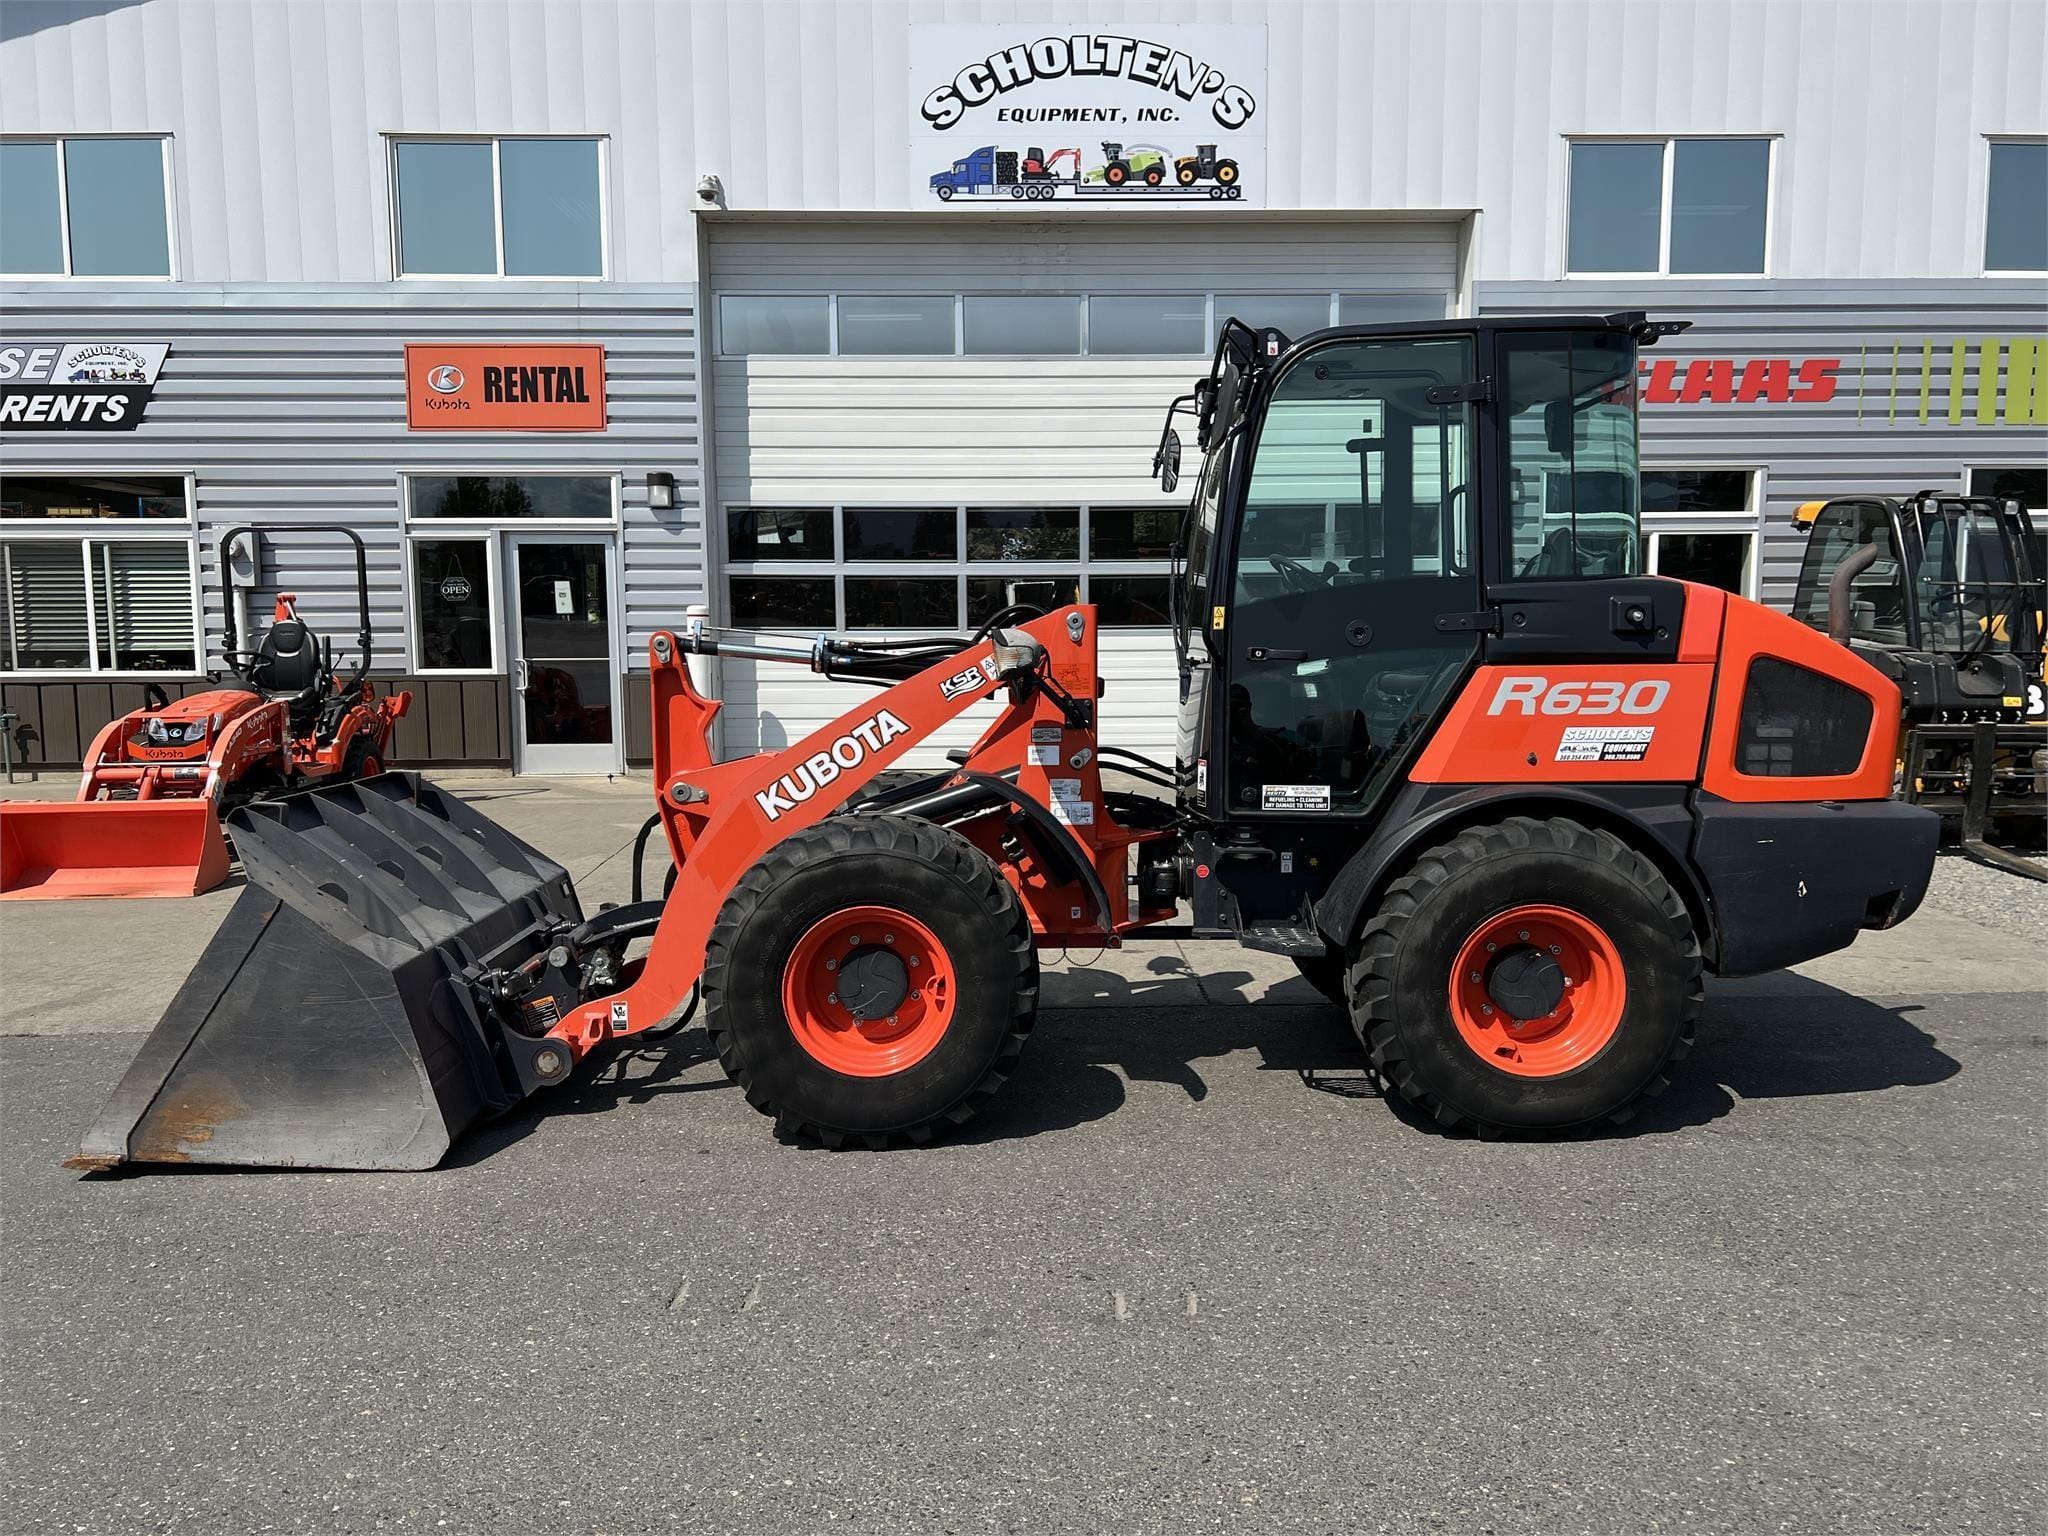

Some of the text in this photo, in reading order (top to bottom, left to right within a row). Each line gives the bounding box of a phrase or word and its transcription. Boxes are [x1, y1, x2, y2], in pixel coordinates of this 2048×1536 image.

[921, 35, 1256, 130] SCHOLTEN'S
[997, 107, 1181, 124] EQUIPMENT, INC.
[67, 344, 147, 368] SCHOLTEN'S
[483, 366, 590, 403] RENTAL
[0, 395, 129, 422] RENTS
[425, 398, 471, 410] Kubota
[443, 586, 469, 595] OPEN
[938, 665, 980, 695] KSR
[1486, 676, 1671, 716] R630
[1565, 728, 1652, 741] SCHOLTEN'S
[145, 749, 184, 758] Kubota
[1604, 744, 1648, 753] EQUIPMENT
[754, 708, 911, 822] KUBOTA
